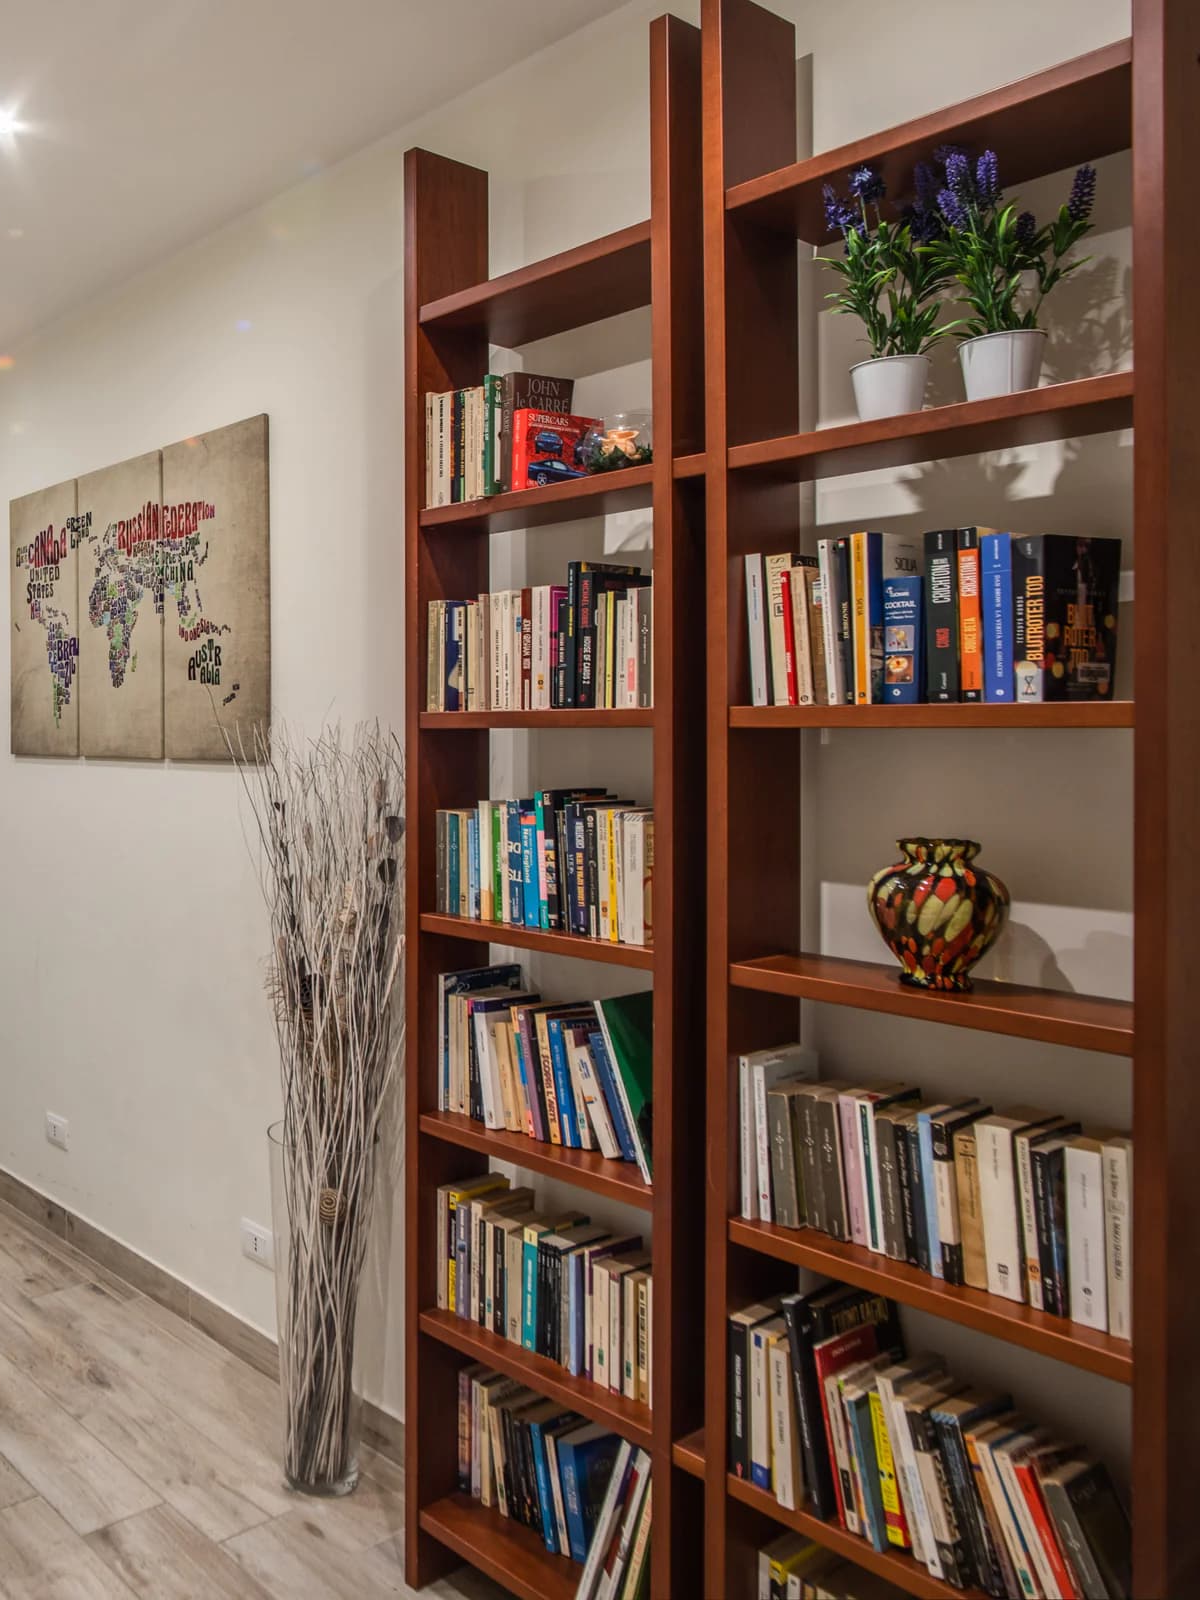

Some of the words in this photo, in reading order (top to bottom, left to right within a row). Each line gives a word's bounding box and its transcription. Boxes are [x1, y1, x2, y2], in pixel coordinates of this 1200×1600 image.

[527, 378, 561, 397] JOHN
[516, 391, 526, 408] le
[528, 395, 570, 414] CARRÉ
[528, 413, 569, 427] SUPERCARS
[118, 500, 159, 557] RUSSIAN
[163, 500, 215, 539] FEDERATION
[28, 524, 67, 568] CANADA
[29, 566, 60, 583] UNITED
[165, 559, 194, 583] CHINA
[769, 557, 785, 600] SINGER
[960, 563, 977, 598] CRICHTON
[993, 574, 1001, 587] DAN
[27, 582, 54, 604] STATES
[931, 564, 951, 604] CRICHTON
[1026, 575, 1044, 596] TOD
[884, 600, 917, 610] COCKTAIL
[994, 609, 1002, 618] LA
[1026, 598, 1044, 661] BLUTROTER
[583, 635, 592, 653] HOUSE
[582, 662, 591, 680] CARDS
[522, 849, 531, 883] England
